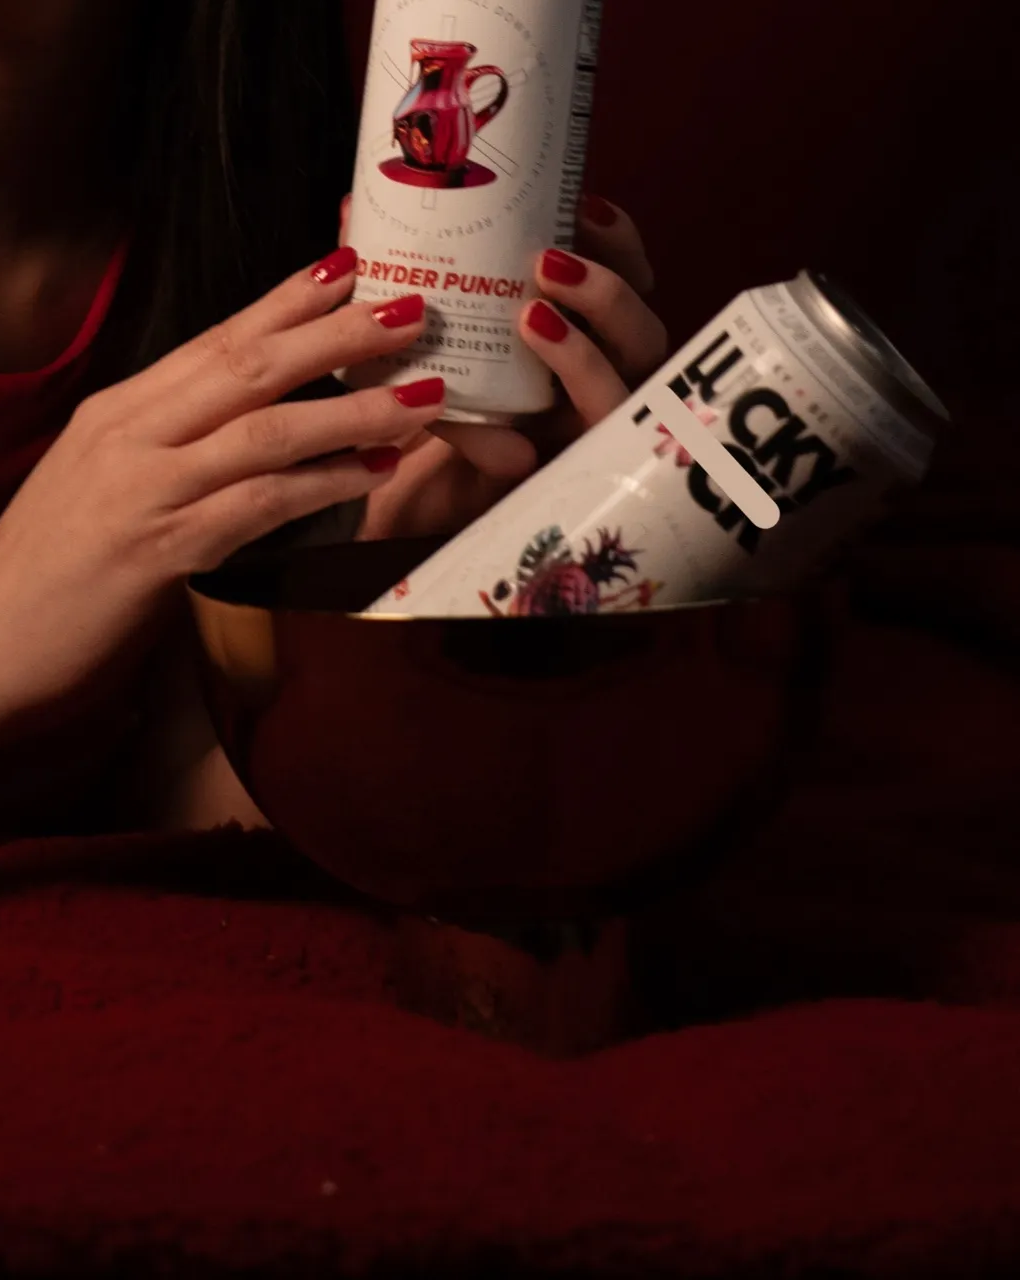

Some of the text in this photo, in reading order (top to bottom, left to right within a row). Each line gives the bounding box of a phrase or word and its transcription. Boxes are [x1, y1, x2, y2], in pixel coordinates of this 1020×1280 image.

[388, 249, 456, 265] SPARKLING
[370, 261, 440, 290] RYDER
[444, 273, 524, 299] PUNCH
[416, 334, 512, 354] NGREDIENTS
[685, 329, 858, 504] LUCKY
